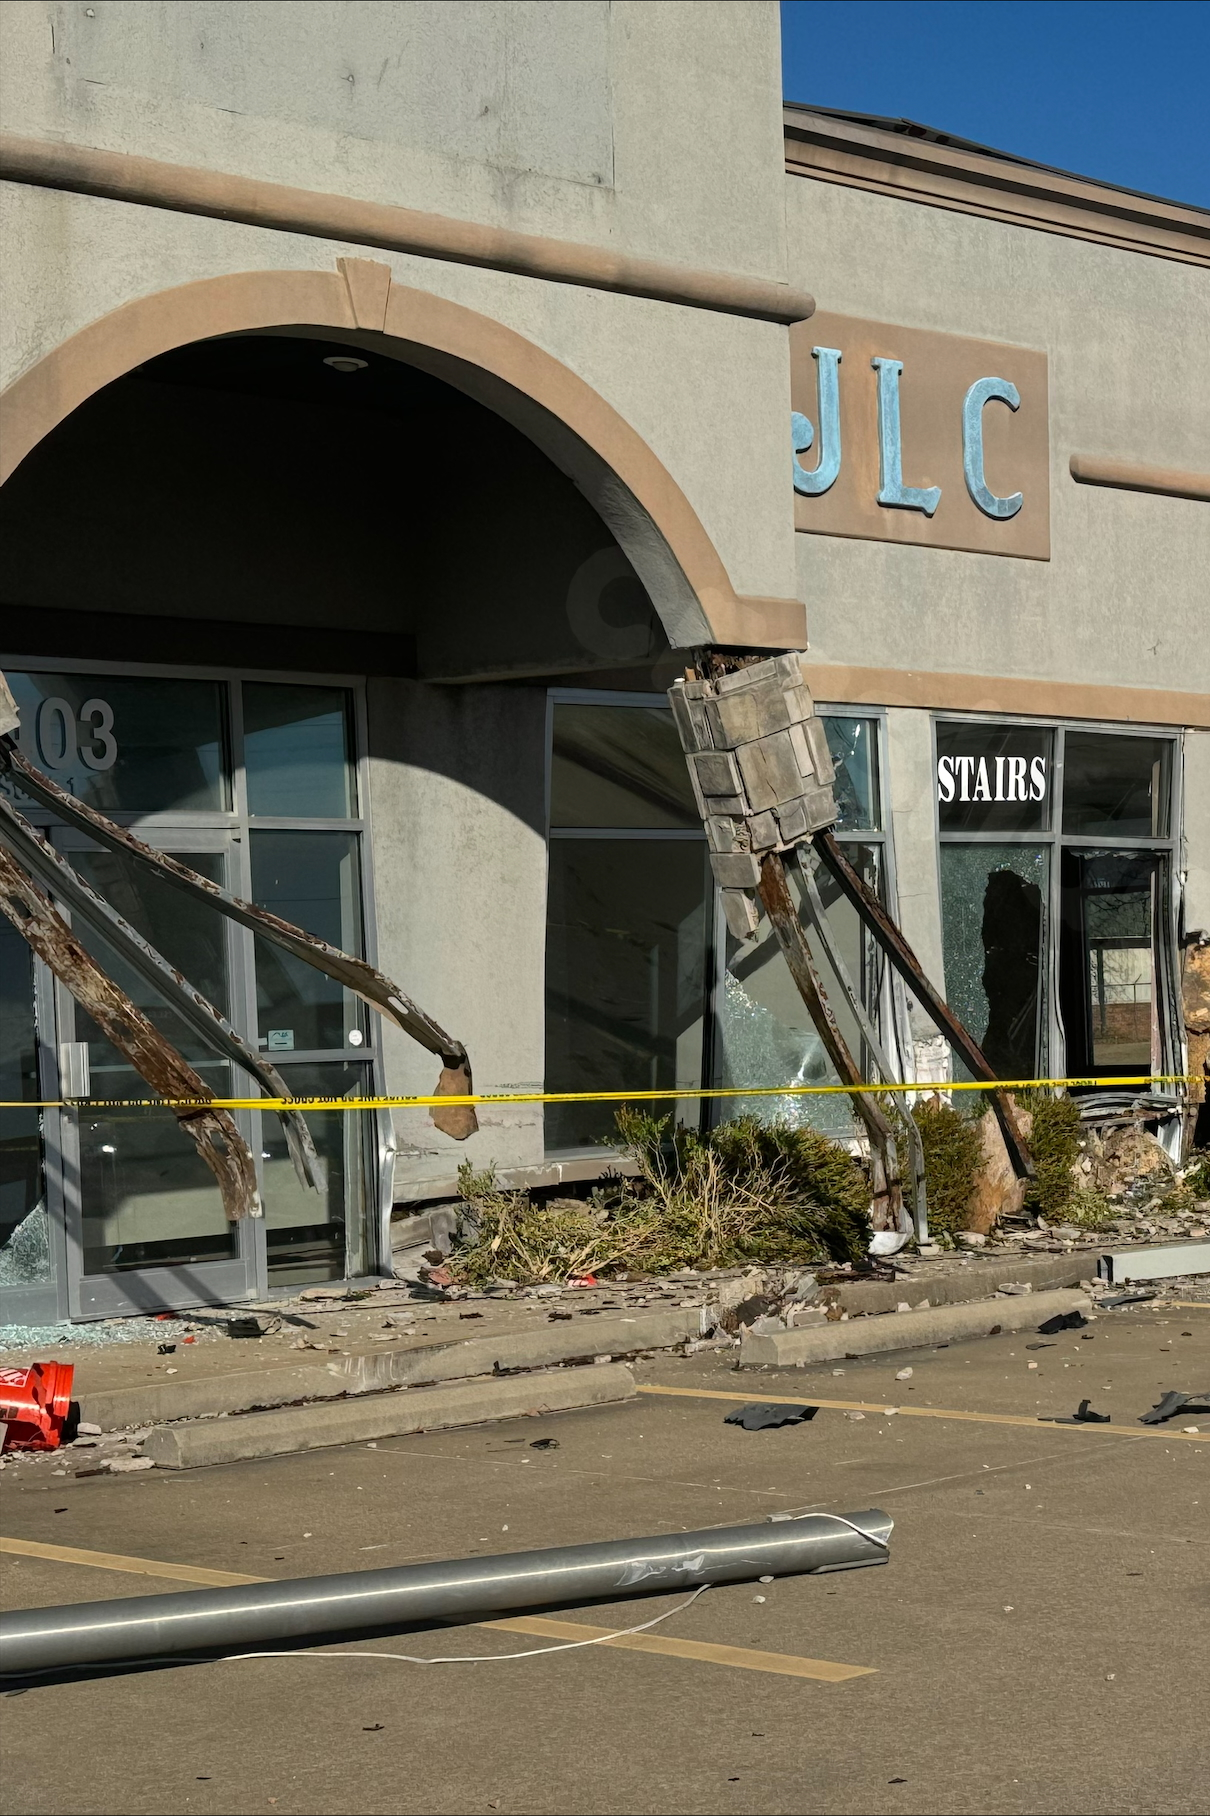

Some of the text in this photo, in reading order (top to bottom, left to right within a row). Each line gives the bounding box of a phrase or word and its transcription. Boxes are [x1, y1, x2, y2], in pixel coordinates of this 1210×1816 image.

[791, 346, 1024, 521] JLC
[13, 696, 118, 771] 03
[937, 755, 1046, 803] STAIRS
